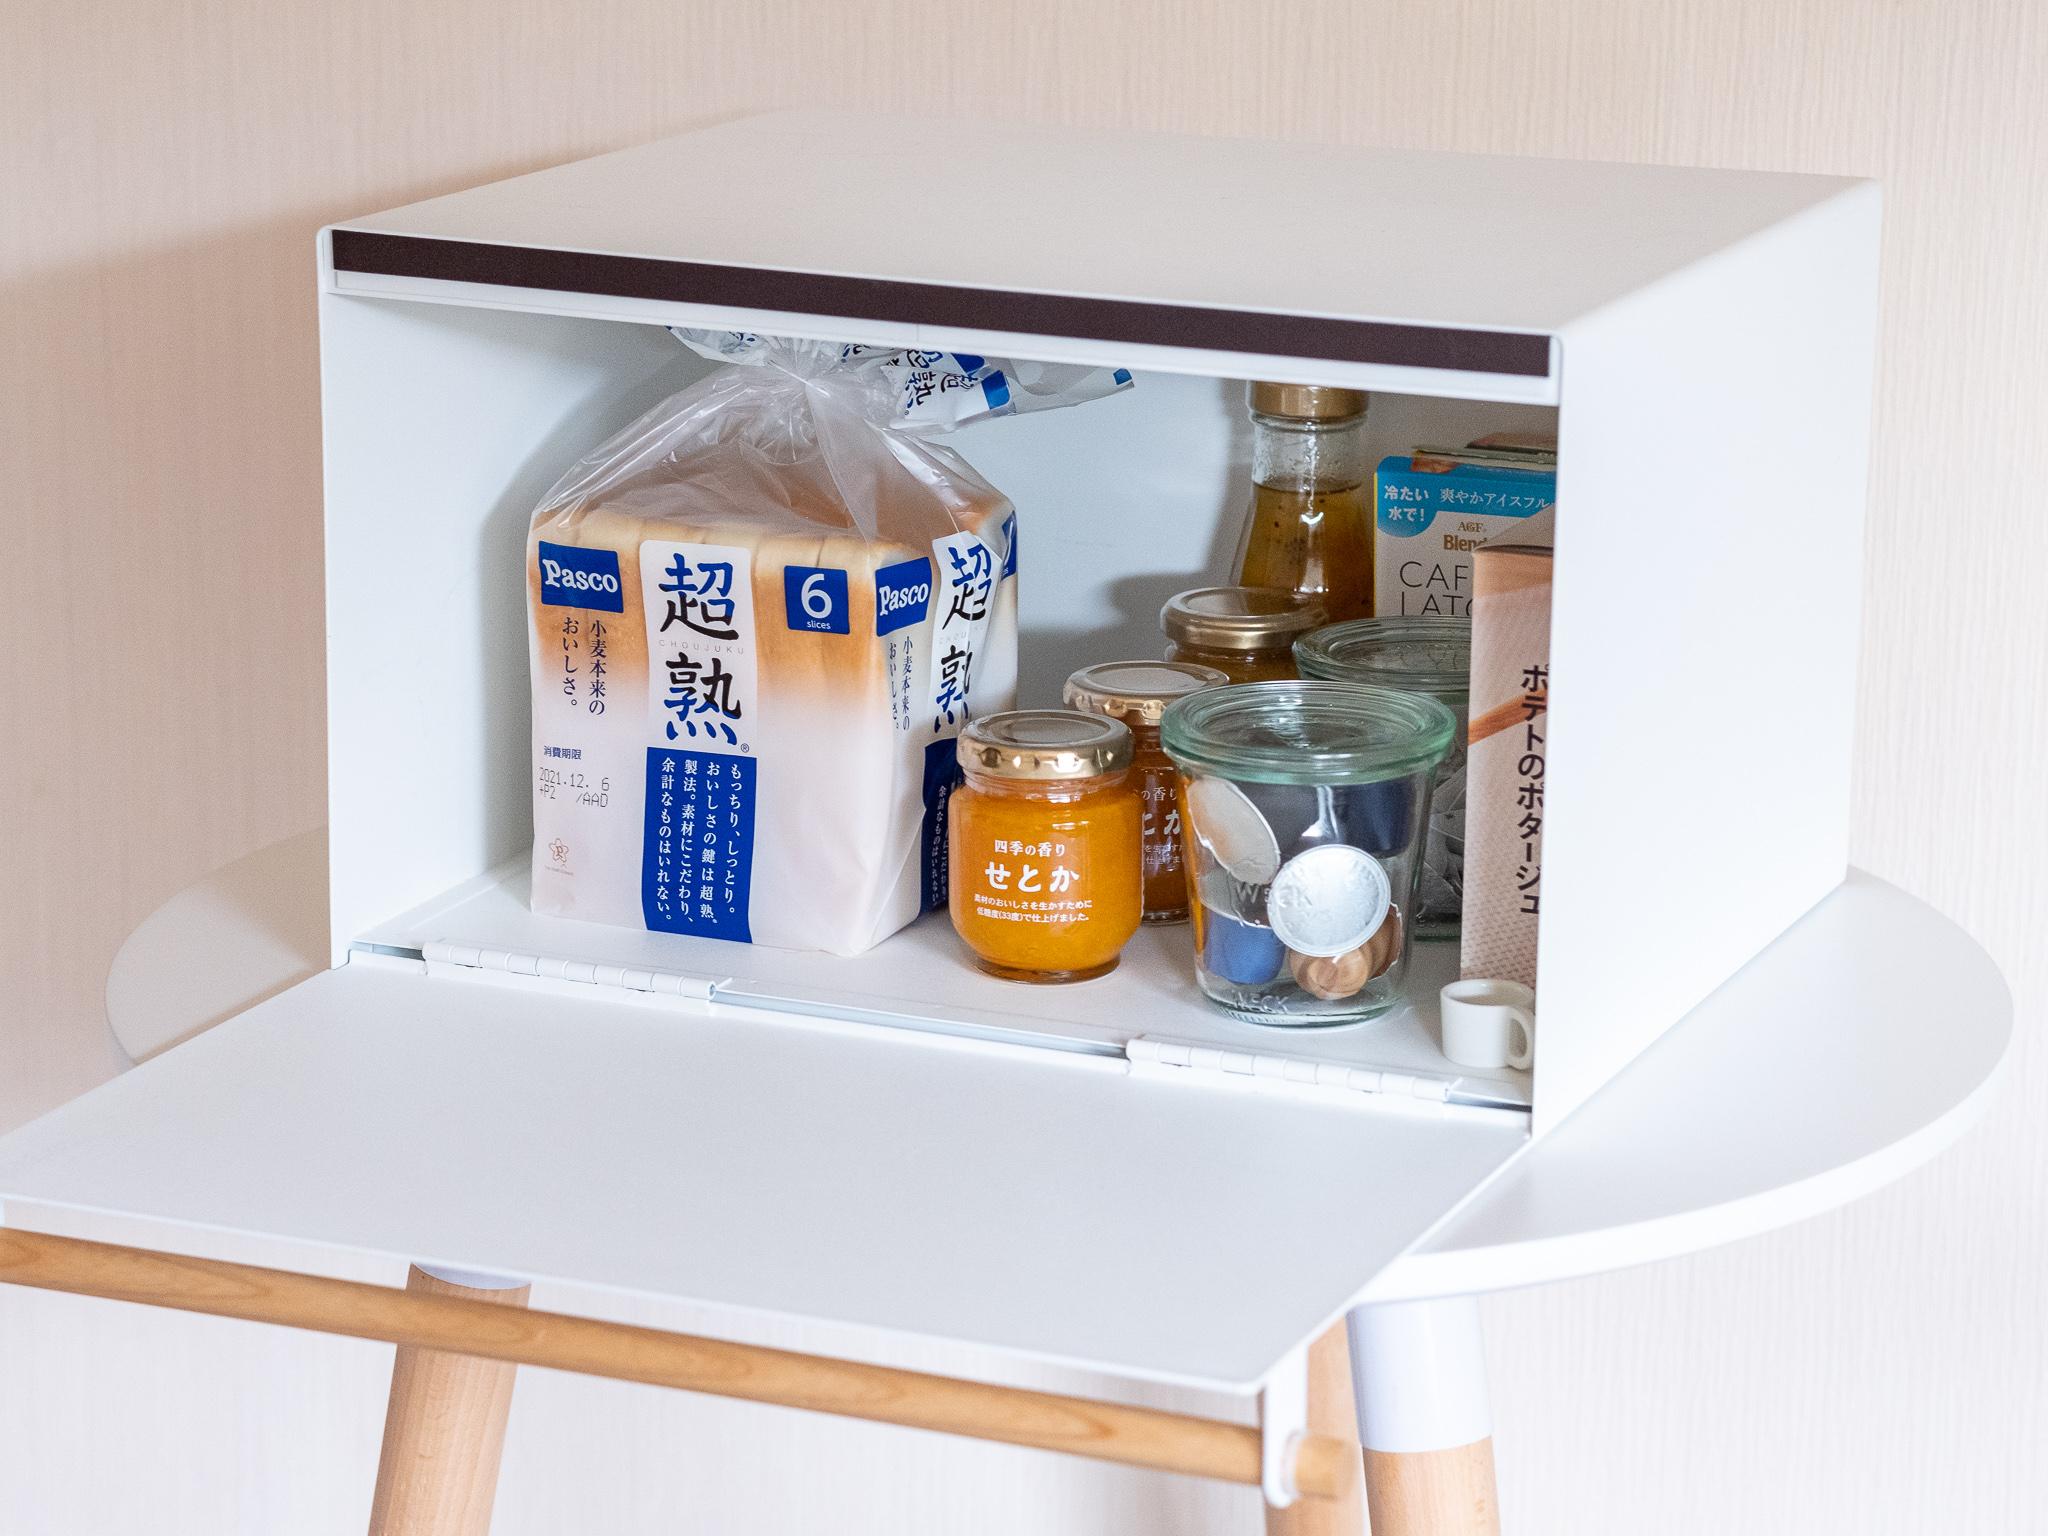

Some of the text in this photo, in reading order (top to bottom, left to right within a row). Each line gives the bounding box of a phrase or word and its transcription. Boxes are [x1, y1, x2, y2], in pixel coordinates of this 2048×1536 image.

[1384, 484, 1430, 502] 冷たい
[1440, 487, 1556, 510] 爽やかアイスフル
[1388, 506, 1425, 523] 水で!
[542, 558, 619, 593] Pasco
[800, 573, 833, 619] 6
[879, 582, 929, 617] Pasco
[806, 619, 832, 630] slices
[658, 638, 745, 655] CHOUJUKU
[658, 552, 742, 746] 超熟
[588, 620, 607, 716] 小麦本来の
[543, 745, 583, 761] 消費期限
[600, 776, 611, 792] 6
[723, 763, 743, 915] もっちり、しっとり。
[994, 839, 1066, 858] 四季の香り
[984, 861, 1081, 893] せとか
